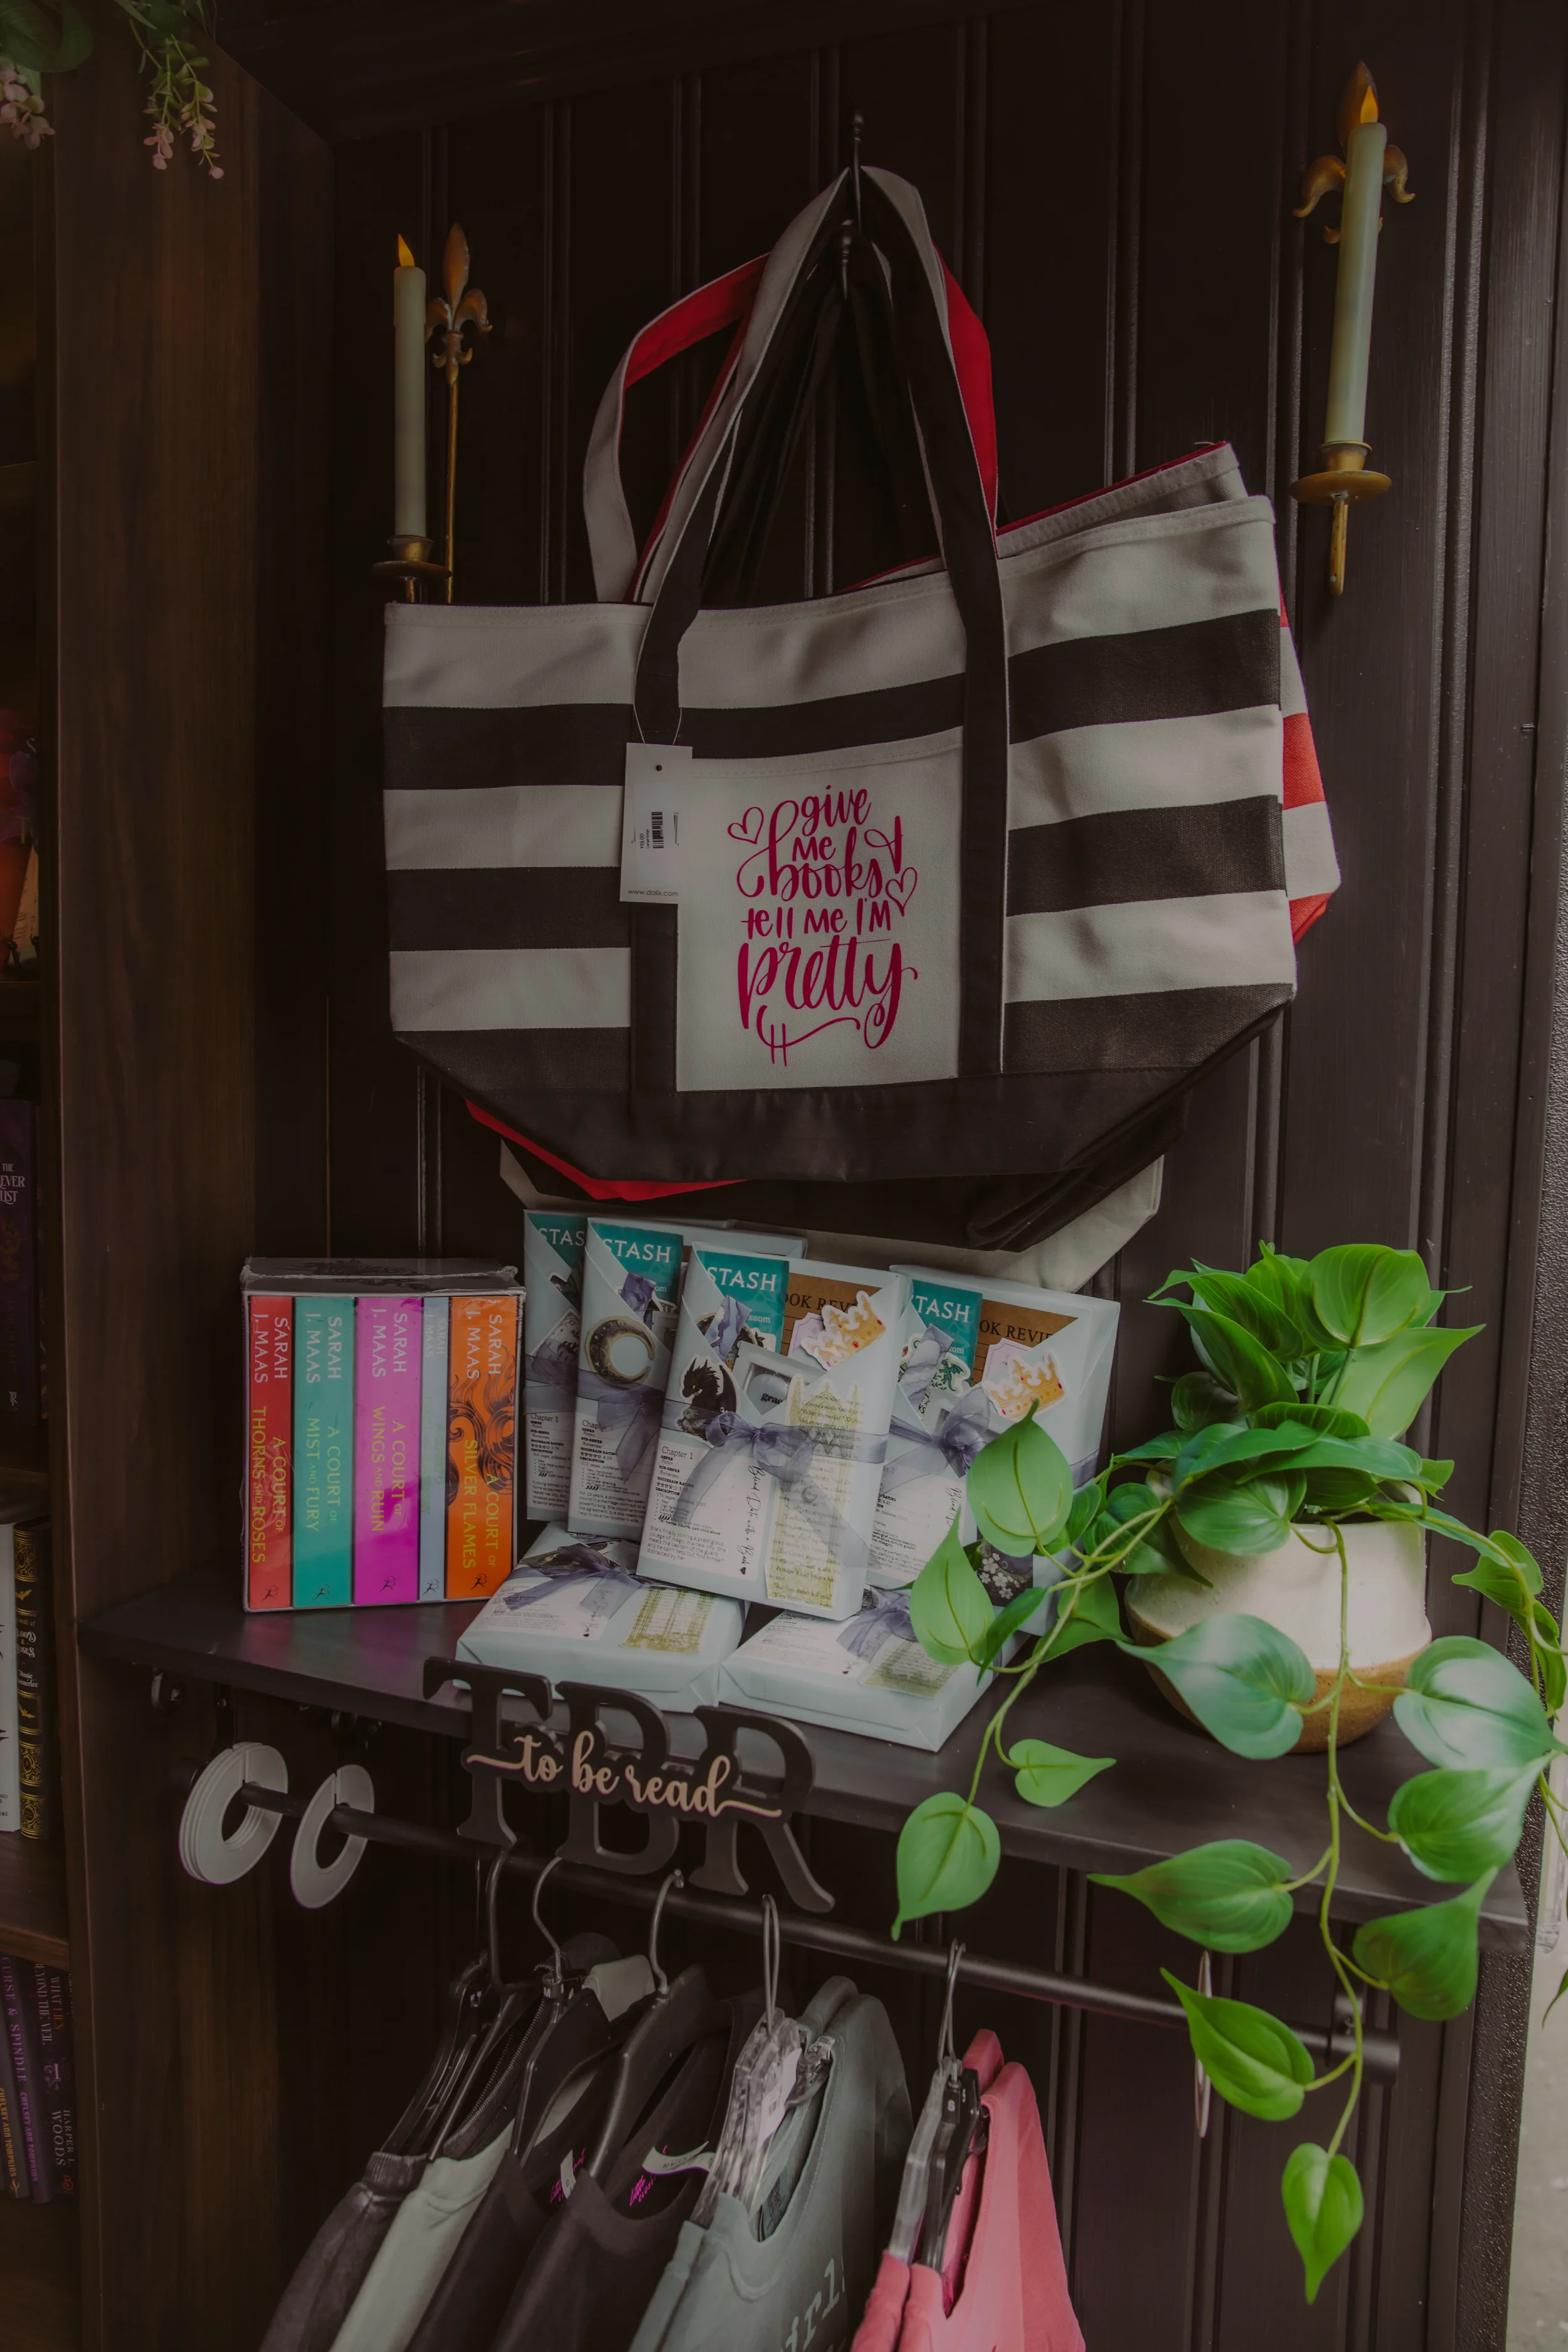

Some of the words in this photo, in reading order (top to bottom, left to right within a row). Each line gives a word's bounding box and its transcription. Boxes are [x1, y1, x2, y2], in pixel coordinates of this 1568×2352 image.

[800, 784, 872, 837] give
[736, 800, 883, 901] books
[628, 888, 679, 898] www.dalix.com
[740, 906, 794, 940] tell
[737, 935, 919, 1049] pretty
[0, 1175, 26, 1189] EVER
[1, 1163, 14, 1172] THE
[538, 1227, 585, 1246] STAS
[602, 1238, 672, 1263] STASH
[706, 1266, 777, 1292] STASH
[370, 1308, 387, 1318] J.
[465, 1310, 481, 1320] J.
[785, 1292, 812, 1309] OK
[911, 1295, 970, 1322] TASH
[252, 1313, 269, 1323] J.
[304, 1313, 322, 1323] J.
[748, 1314, 771, 1324] ssom
[979, 1319, 1001, 1336] OK
[274, 1317, 289, 1379] SARAH
[327, 1316, 342, 1379] SARAH
[393, 1312, 408, 1372] SARAH
[425, 1324, 435, 1358] MAAS
[437, 1317, 447, 1354] SARAH
[487, 1314, 503, 1375] SARAH
[255, 1330, 269, 1383] MAAS
[305, 1330, 322, 1384] MAAS
[372, 1325, 387, 1377] MAAS
[466, 1327, 481, 1379] MAAS
[305, 1417, 320, 1460] MIST
[327, 1426, 341, 1438] A
[371, 1406, 386, 1463] WINGS
[392, 1420, 406, 1434] A
[252, 1406, 266, 1479] THORNS
[273, 1436, 287, 1449] A
[662, 1446, 687, 1458] Chapter
[309, 1463, 317, 1484] AND
[326, 1445, 341, 1507] COURT
[374, 1466, 383, 1487] AND
[391, 1440, 406, 1501] COURT
[464, 1439, 478, 1496] SILVER
[486, 1473, 499, 1485] A
[748, 1465, 765, 1491] Blind
[253, 1482, 263, 1503] AND
[273, 1456, 287, 1518] COURT
[305, 1487, 320, 1532] FURY
[329, 1510, 338, 1524] OF
[370, 1490, 384, 1531] RUIN
[394, 1503, 403, 1516] OF
[485, 1491, 499, 1549] COURT
[746, 1492, 761, 1519] Date
[252, 1506, 266, 1563] ROSES
[275, 1519, 283, 1532] OF
[462, 1502, 477, 1569] FLAMES
[745, 1519, 756, 1539] with
[487, 1555, 496, 1567] OF
[736, 1544, 755, 1565] Book
[423, 1656, 835, 1914] TBR
[466, 1734, 564, 1783] to
[571, 1730, 620, 1794] be
[625, 1754, 783, 1818] read
[1, 1957, 16, 2000] CURSE
[50, 1976, 62, 2005] WHAT
[8, 2008, 18, 2016] &
[38, 2000, 50, 2020] THE
[52, 2008, 64, 2030] LIES
[40, 2023, 53, 2046] VEIL
[9, 2023, 27, 2082] SPINDLE
[19, 2091, 31, 2128] CHELSEY
[27, 2143, 38, 2182] TOMPKINS
[51, 2109, 66, 2166] WOODS
[63, 2109, 74, 2154] HARPER
[4, 2139, 17, 2178] TOMPKINS
